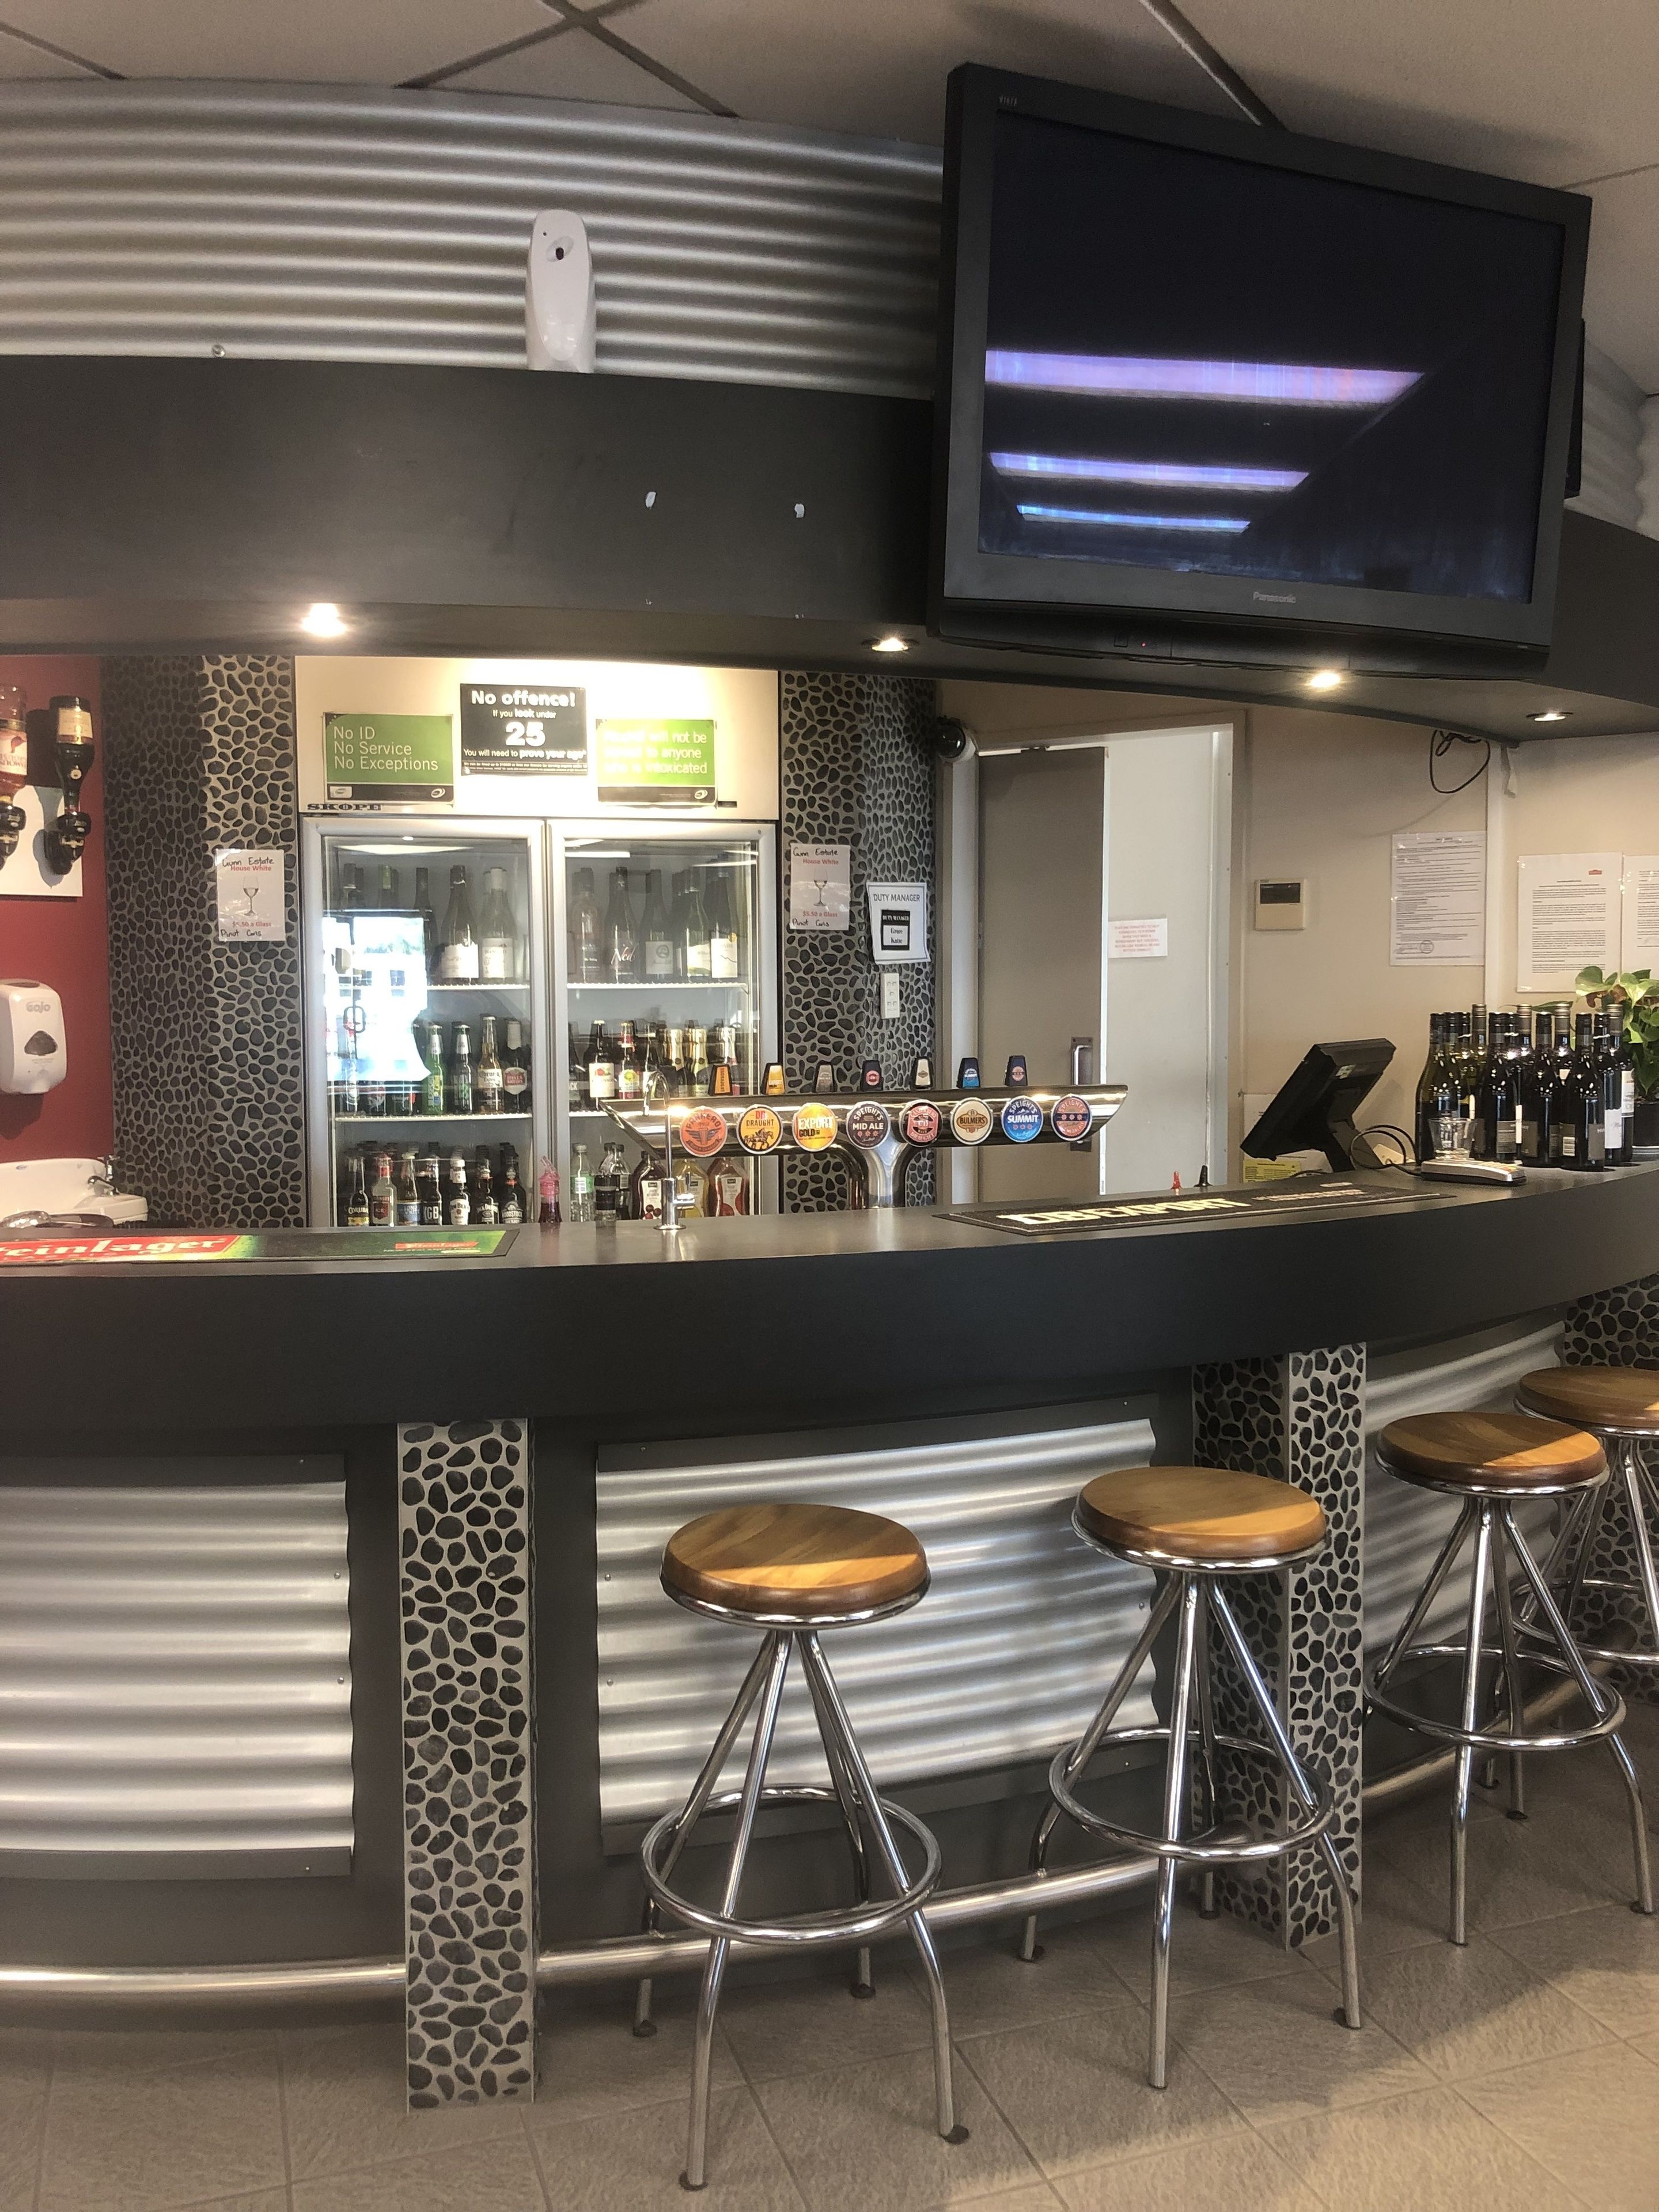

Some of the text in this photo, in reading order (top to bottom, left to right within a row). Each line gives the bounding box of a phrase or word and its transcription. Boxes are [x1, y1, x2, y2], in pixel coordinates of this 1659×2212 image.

[471, 690, 575, 707] No offence!
[499, 711, 513, 719] you
[536, 710, 557, 719] under
[334, 726, 375, 740] No ID
[505, 721, 546, 747] 25
[672, 732, 690, 744] not
[693, 731, 707, 744] be
[334, 741, 412, 755] No Service
[463, 749, 476, 757] You
[478, 749, 490, 757] will
[519, 749, 544, 759] prove
[546, 750, 566, 760] your
[661, 748, 702, 761] anyone
[334, 755, 438, 772] No Exceptions
[646, 762, 707, 774] intoxicated
[815, 848, 838, 856] Estate
[248, 857, 275, 866] Estate
[873, 893, 921, 902] DUTY MANAGER
[792, 918, 809, 926] Pinot
[220, 929, 239, 937] Pinot
[798, 1116, 833, 1129] EXPORT
[1007, 1115, 1039, 1123] SUMMIT
[799, 1128, 815, 1137] GOLD
[349, 1206, 368, 1214] CORUBA
[996, 1198, 1252, 1225] DB EXPORT
[0, 1238, 227, 1257] einlager
